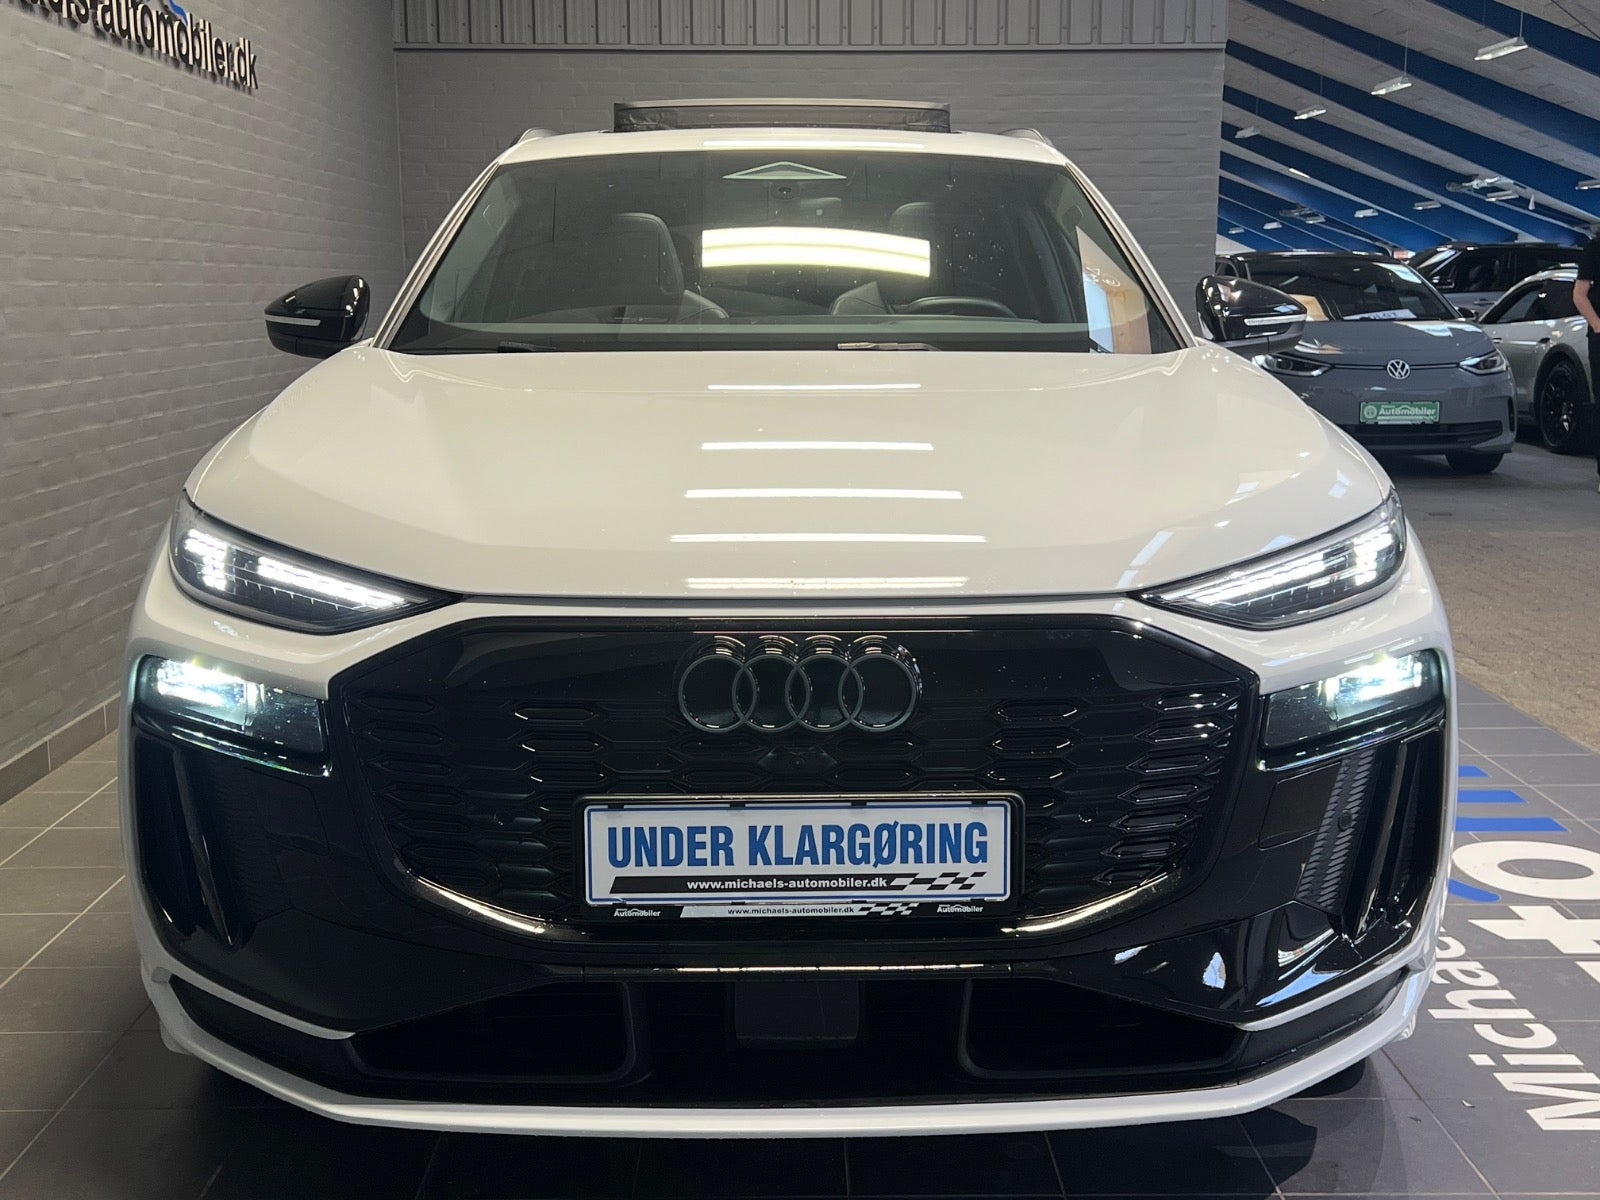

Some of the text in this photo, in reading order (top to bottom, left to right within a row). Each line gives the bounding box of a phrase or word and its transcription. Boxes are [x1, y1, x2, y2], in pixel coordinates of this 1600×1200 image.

[1379, 406, 1436, 416] Automobiler
[608, 820, 988, 868] UNDER KLARGØRING
[687, 876, 887, 890] www.michaels-automobiler.dk
[614, 909, 661, 917] Automobiler
[728, 905, 855, 915] www.michaels-automobiler.dk
[937, 904, 983, 913] Automobiler
